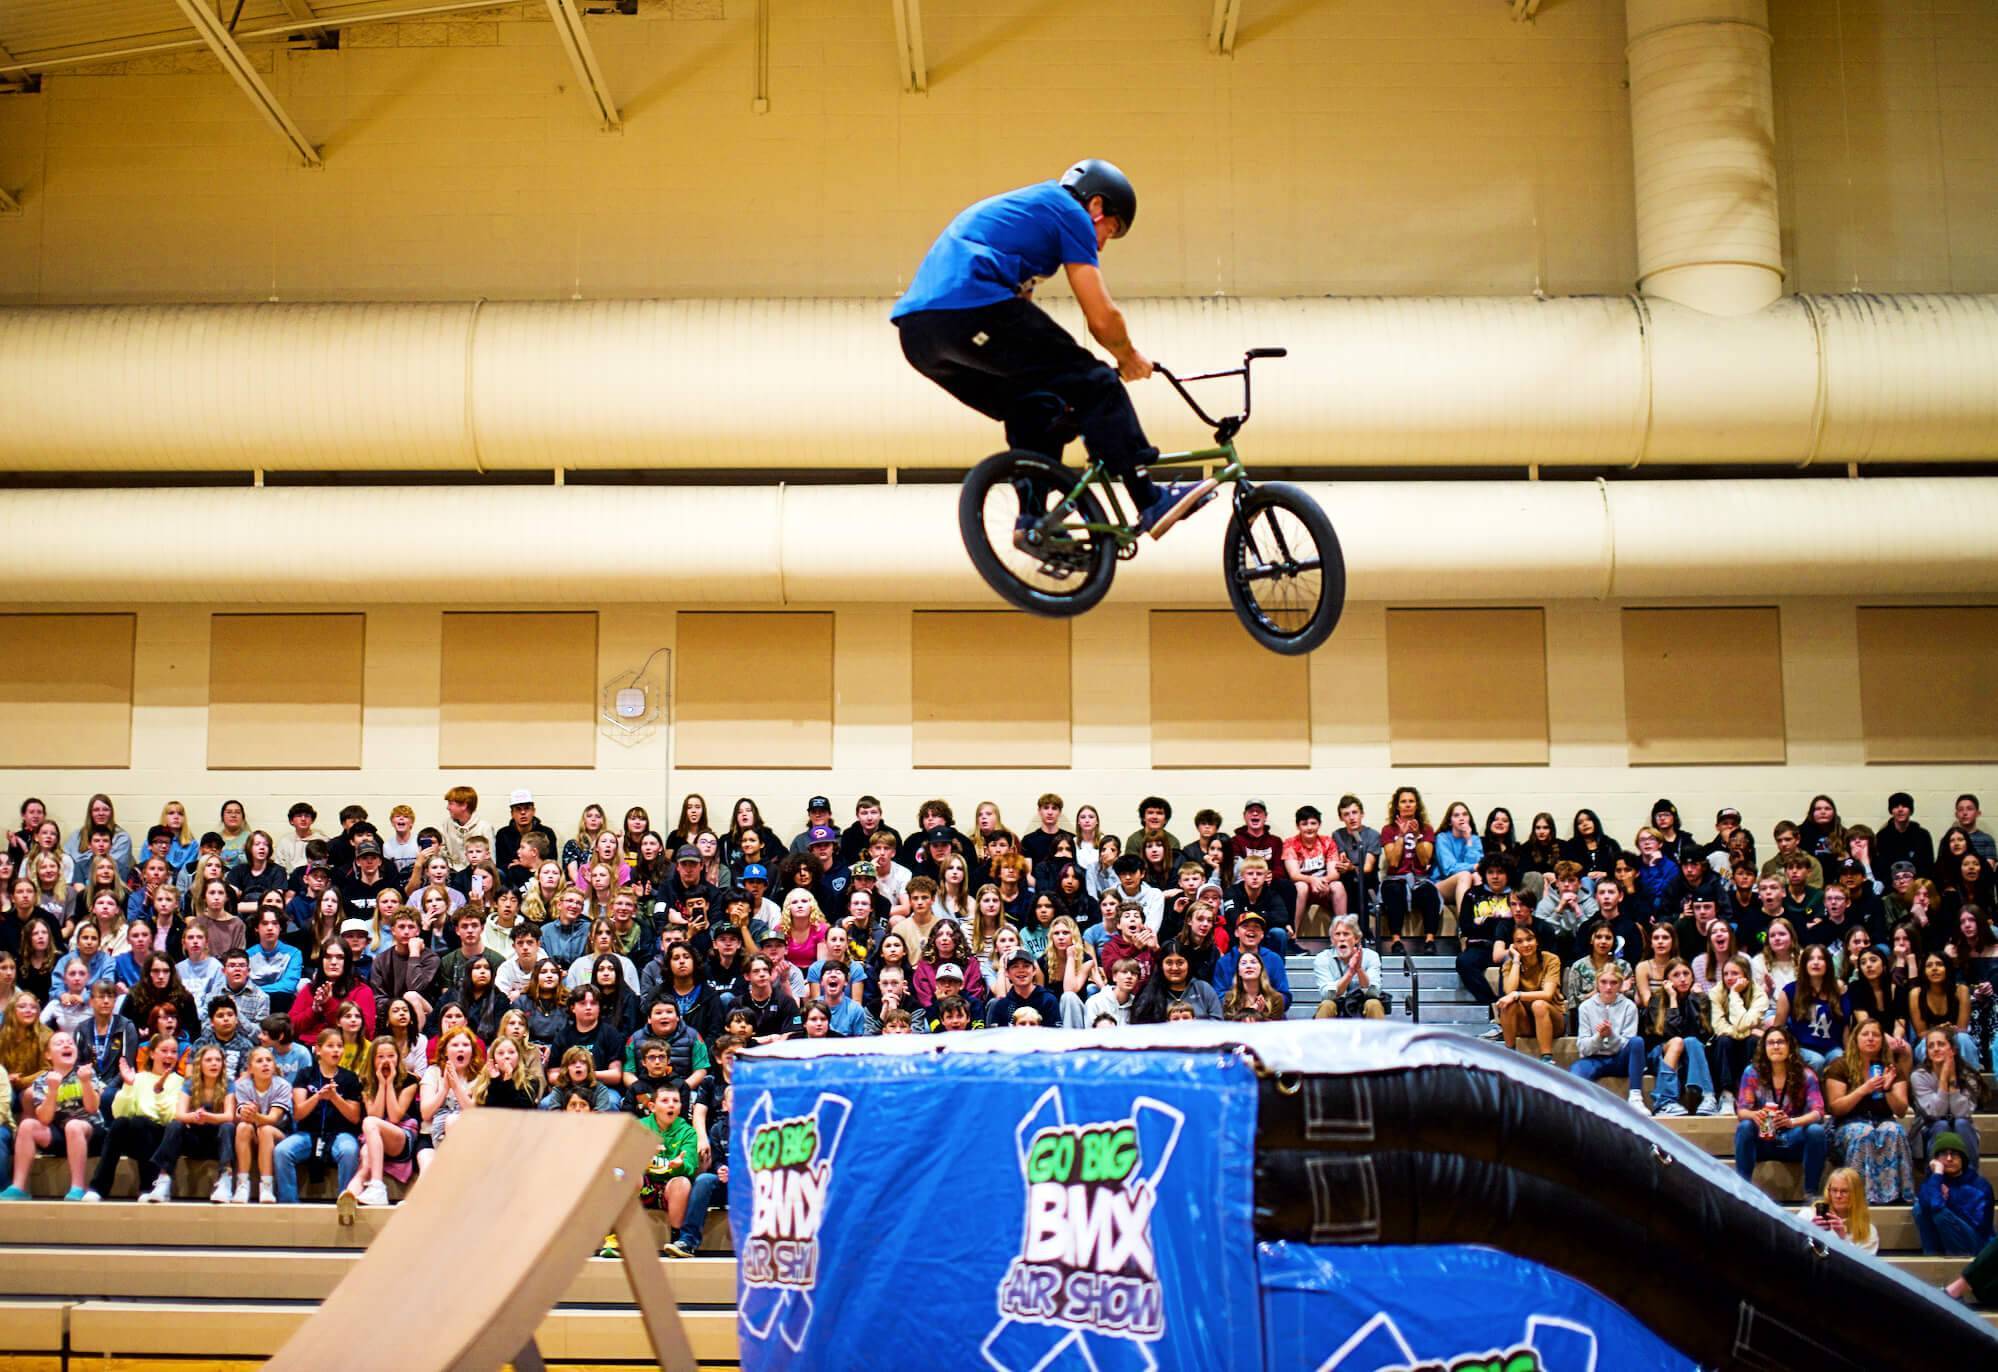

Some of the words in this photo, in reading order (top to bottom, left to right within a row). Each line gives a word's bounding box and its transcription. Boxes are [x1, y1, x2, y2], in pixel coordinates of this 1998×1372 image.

[752, 1129, 780, 1171] GO
[781, 1117, 816, 1167] BIG
[1028, 1132, 1075, 1184] GO
[1080, 1127, 1138, 1182] BIG
[753, 1164, 829, 1240] BMX
[1025, 1181, 1155, 1280] BMX
[1003, 1262, 1062, 1317] AIR
[1063, 1271, 1162, 1333] SHOW
